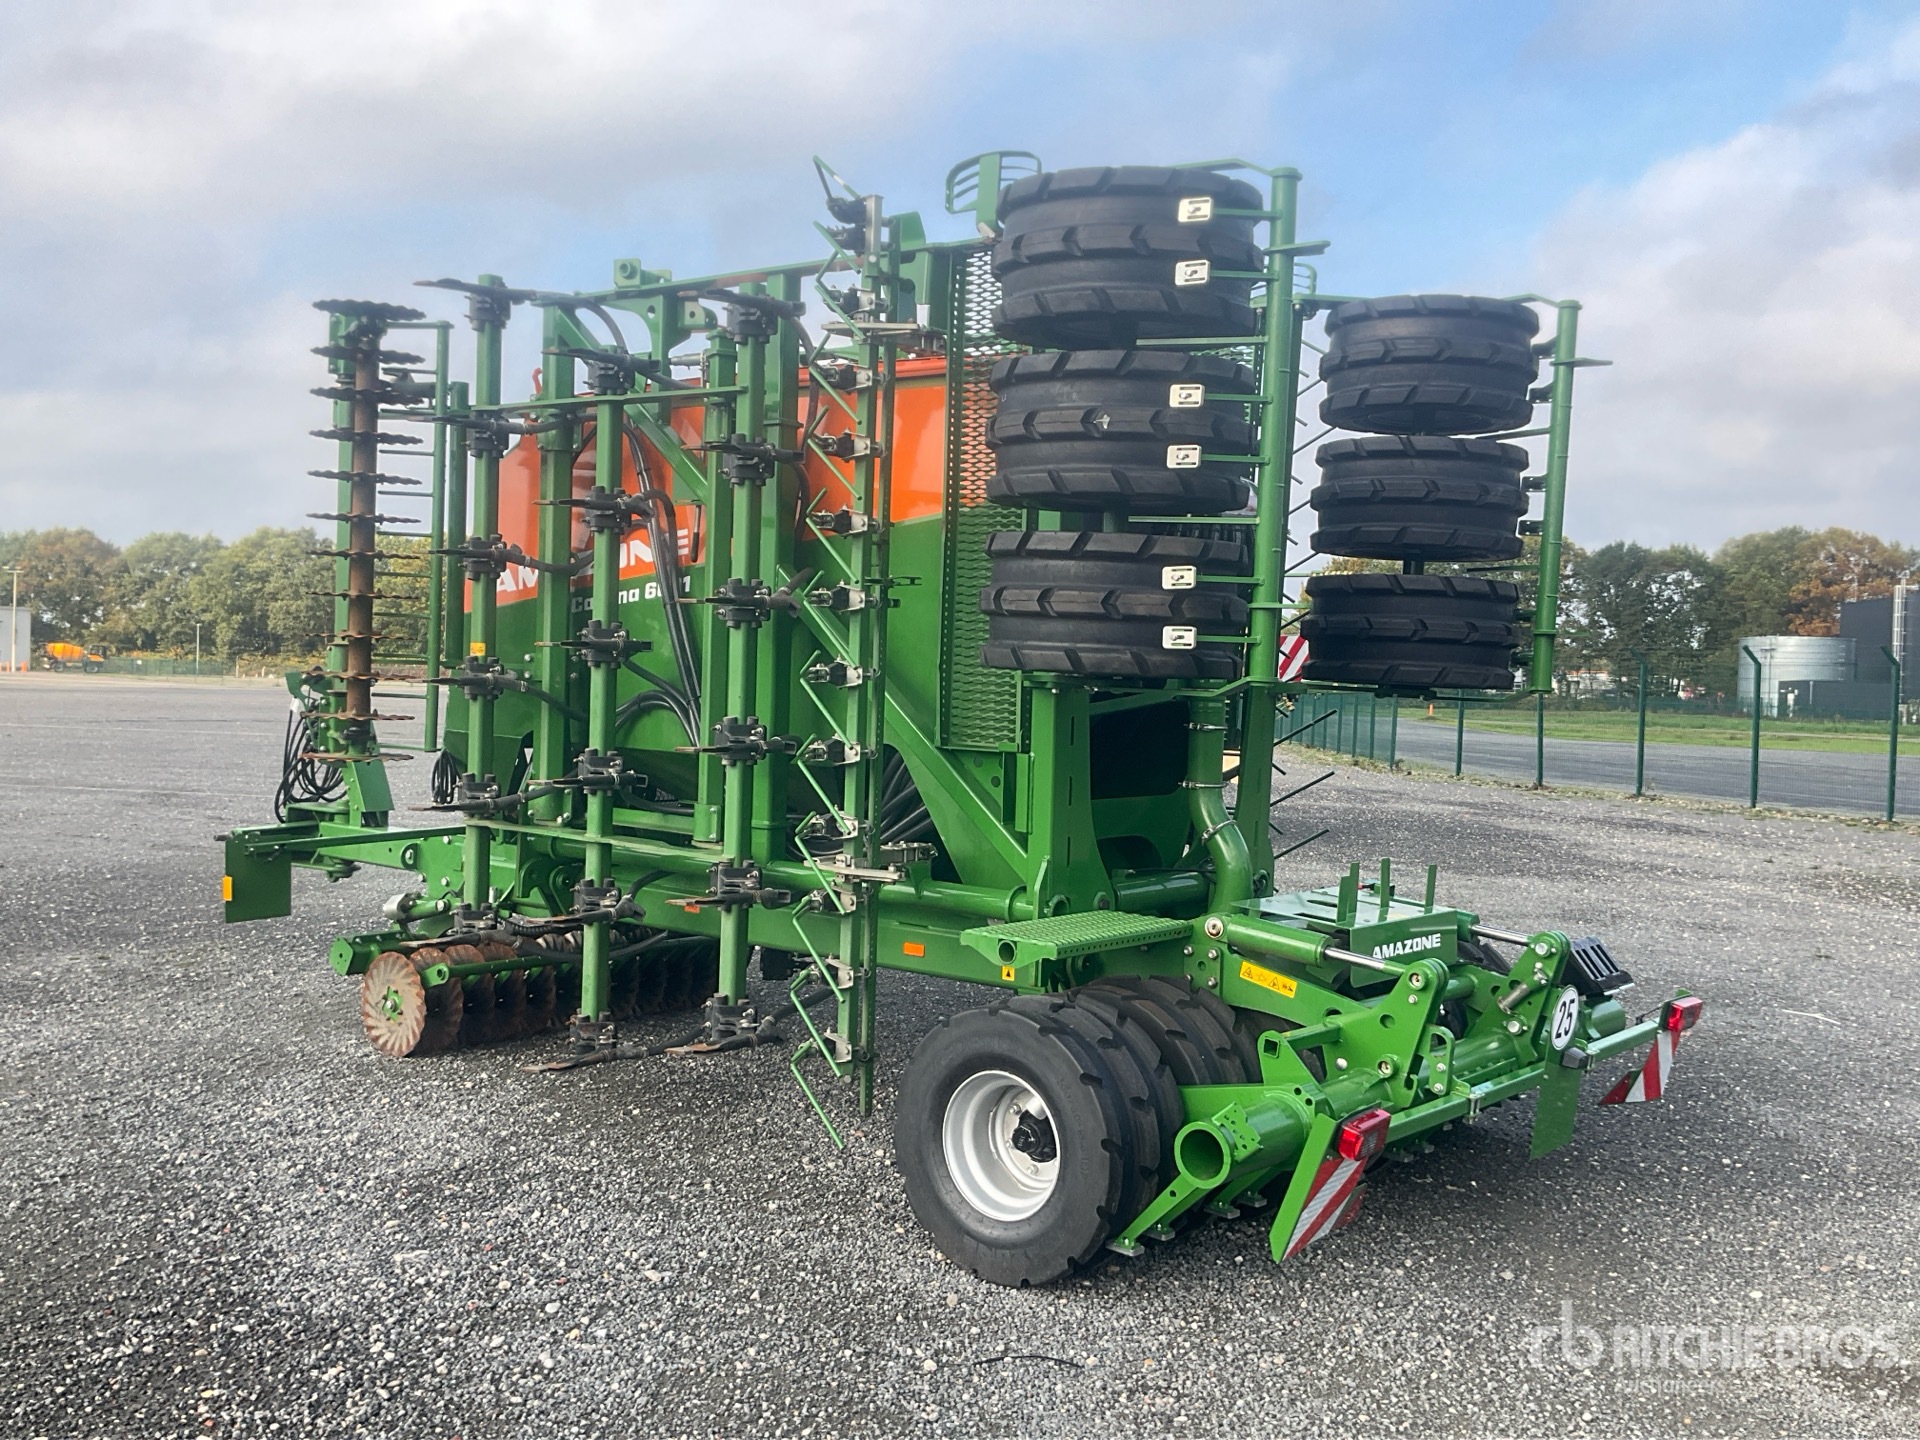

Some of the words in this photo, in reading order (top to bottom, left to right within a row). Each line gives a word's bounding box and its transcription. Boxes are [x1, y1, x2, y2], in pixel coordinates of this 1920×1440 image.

[571, 588, 640, 613] Cana
[1372, 933, 1441, 959] AMAZONE
[1555, 998, 1575, 1039] 25
